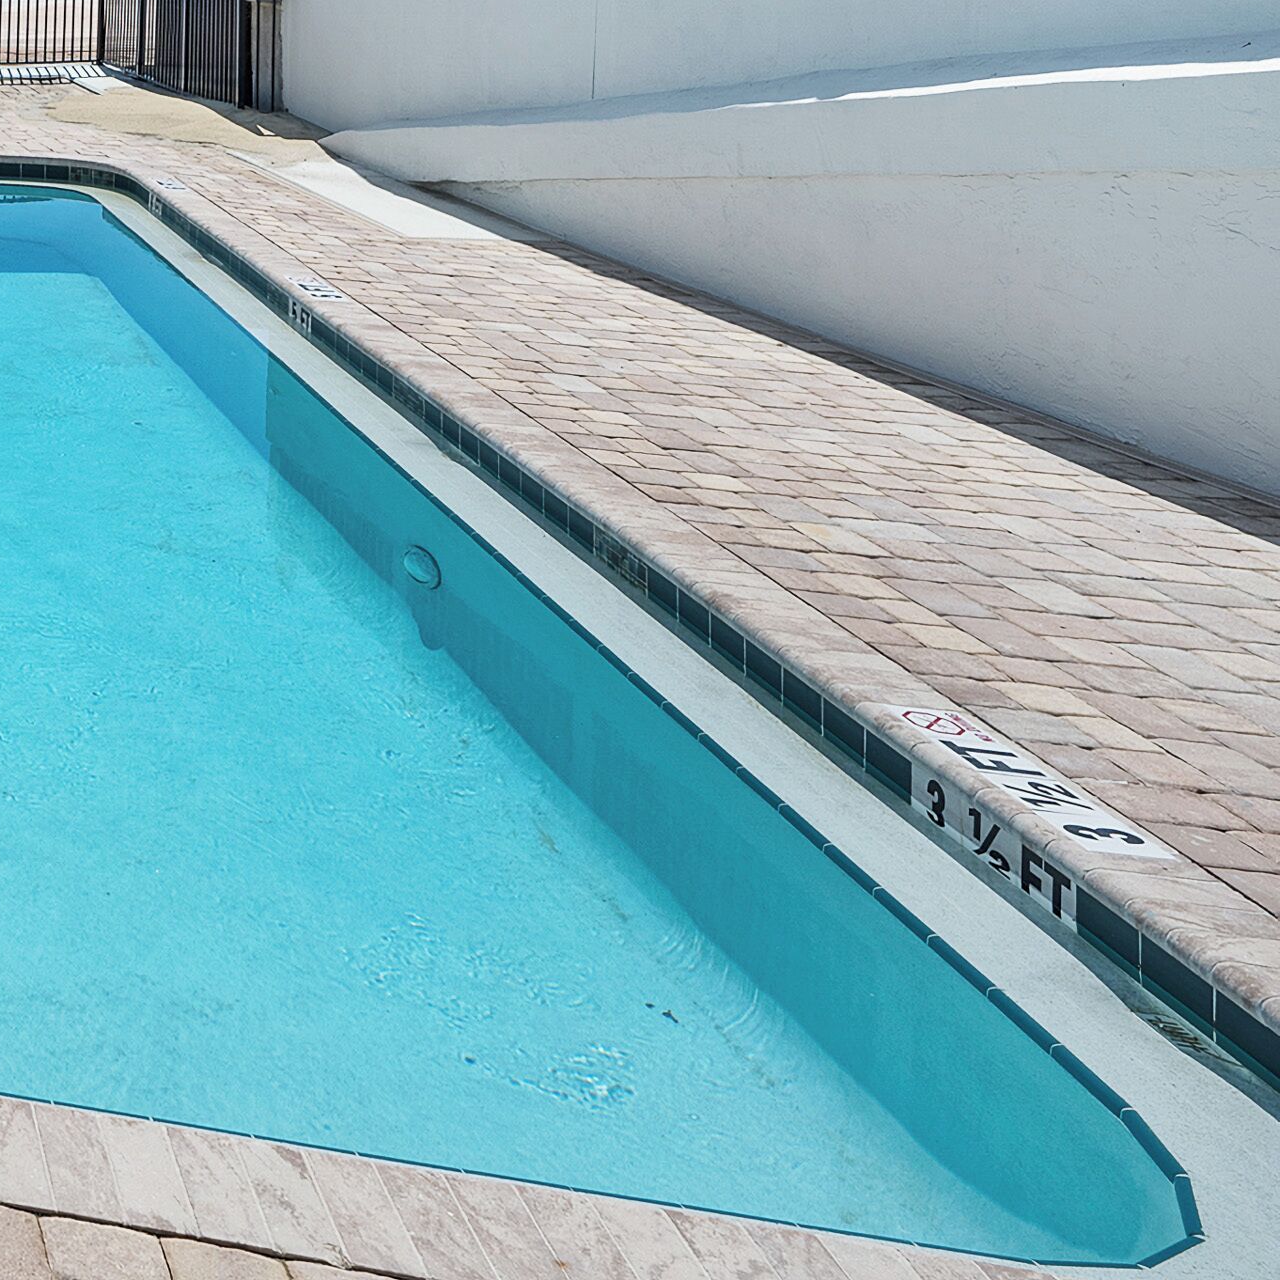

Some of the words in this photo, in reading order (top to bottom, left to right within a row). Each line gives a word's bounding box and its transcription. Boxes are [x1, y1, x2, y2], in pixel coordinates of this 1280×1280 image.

[939, 739, 1047, 777] FT
[926, 779, 946, 827] 3
[1021, 844, 1072, 919] FT
[1063, 824, 1146, 846] 3
